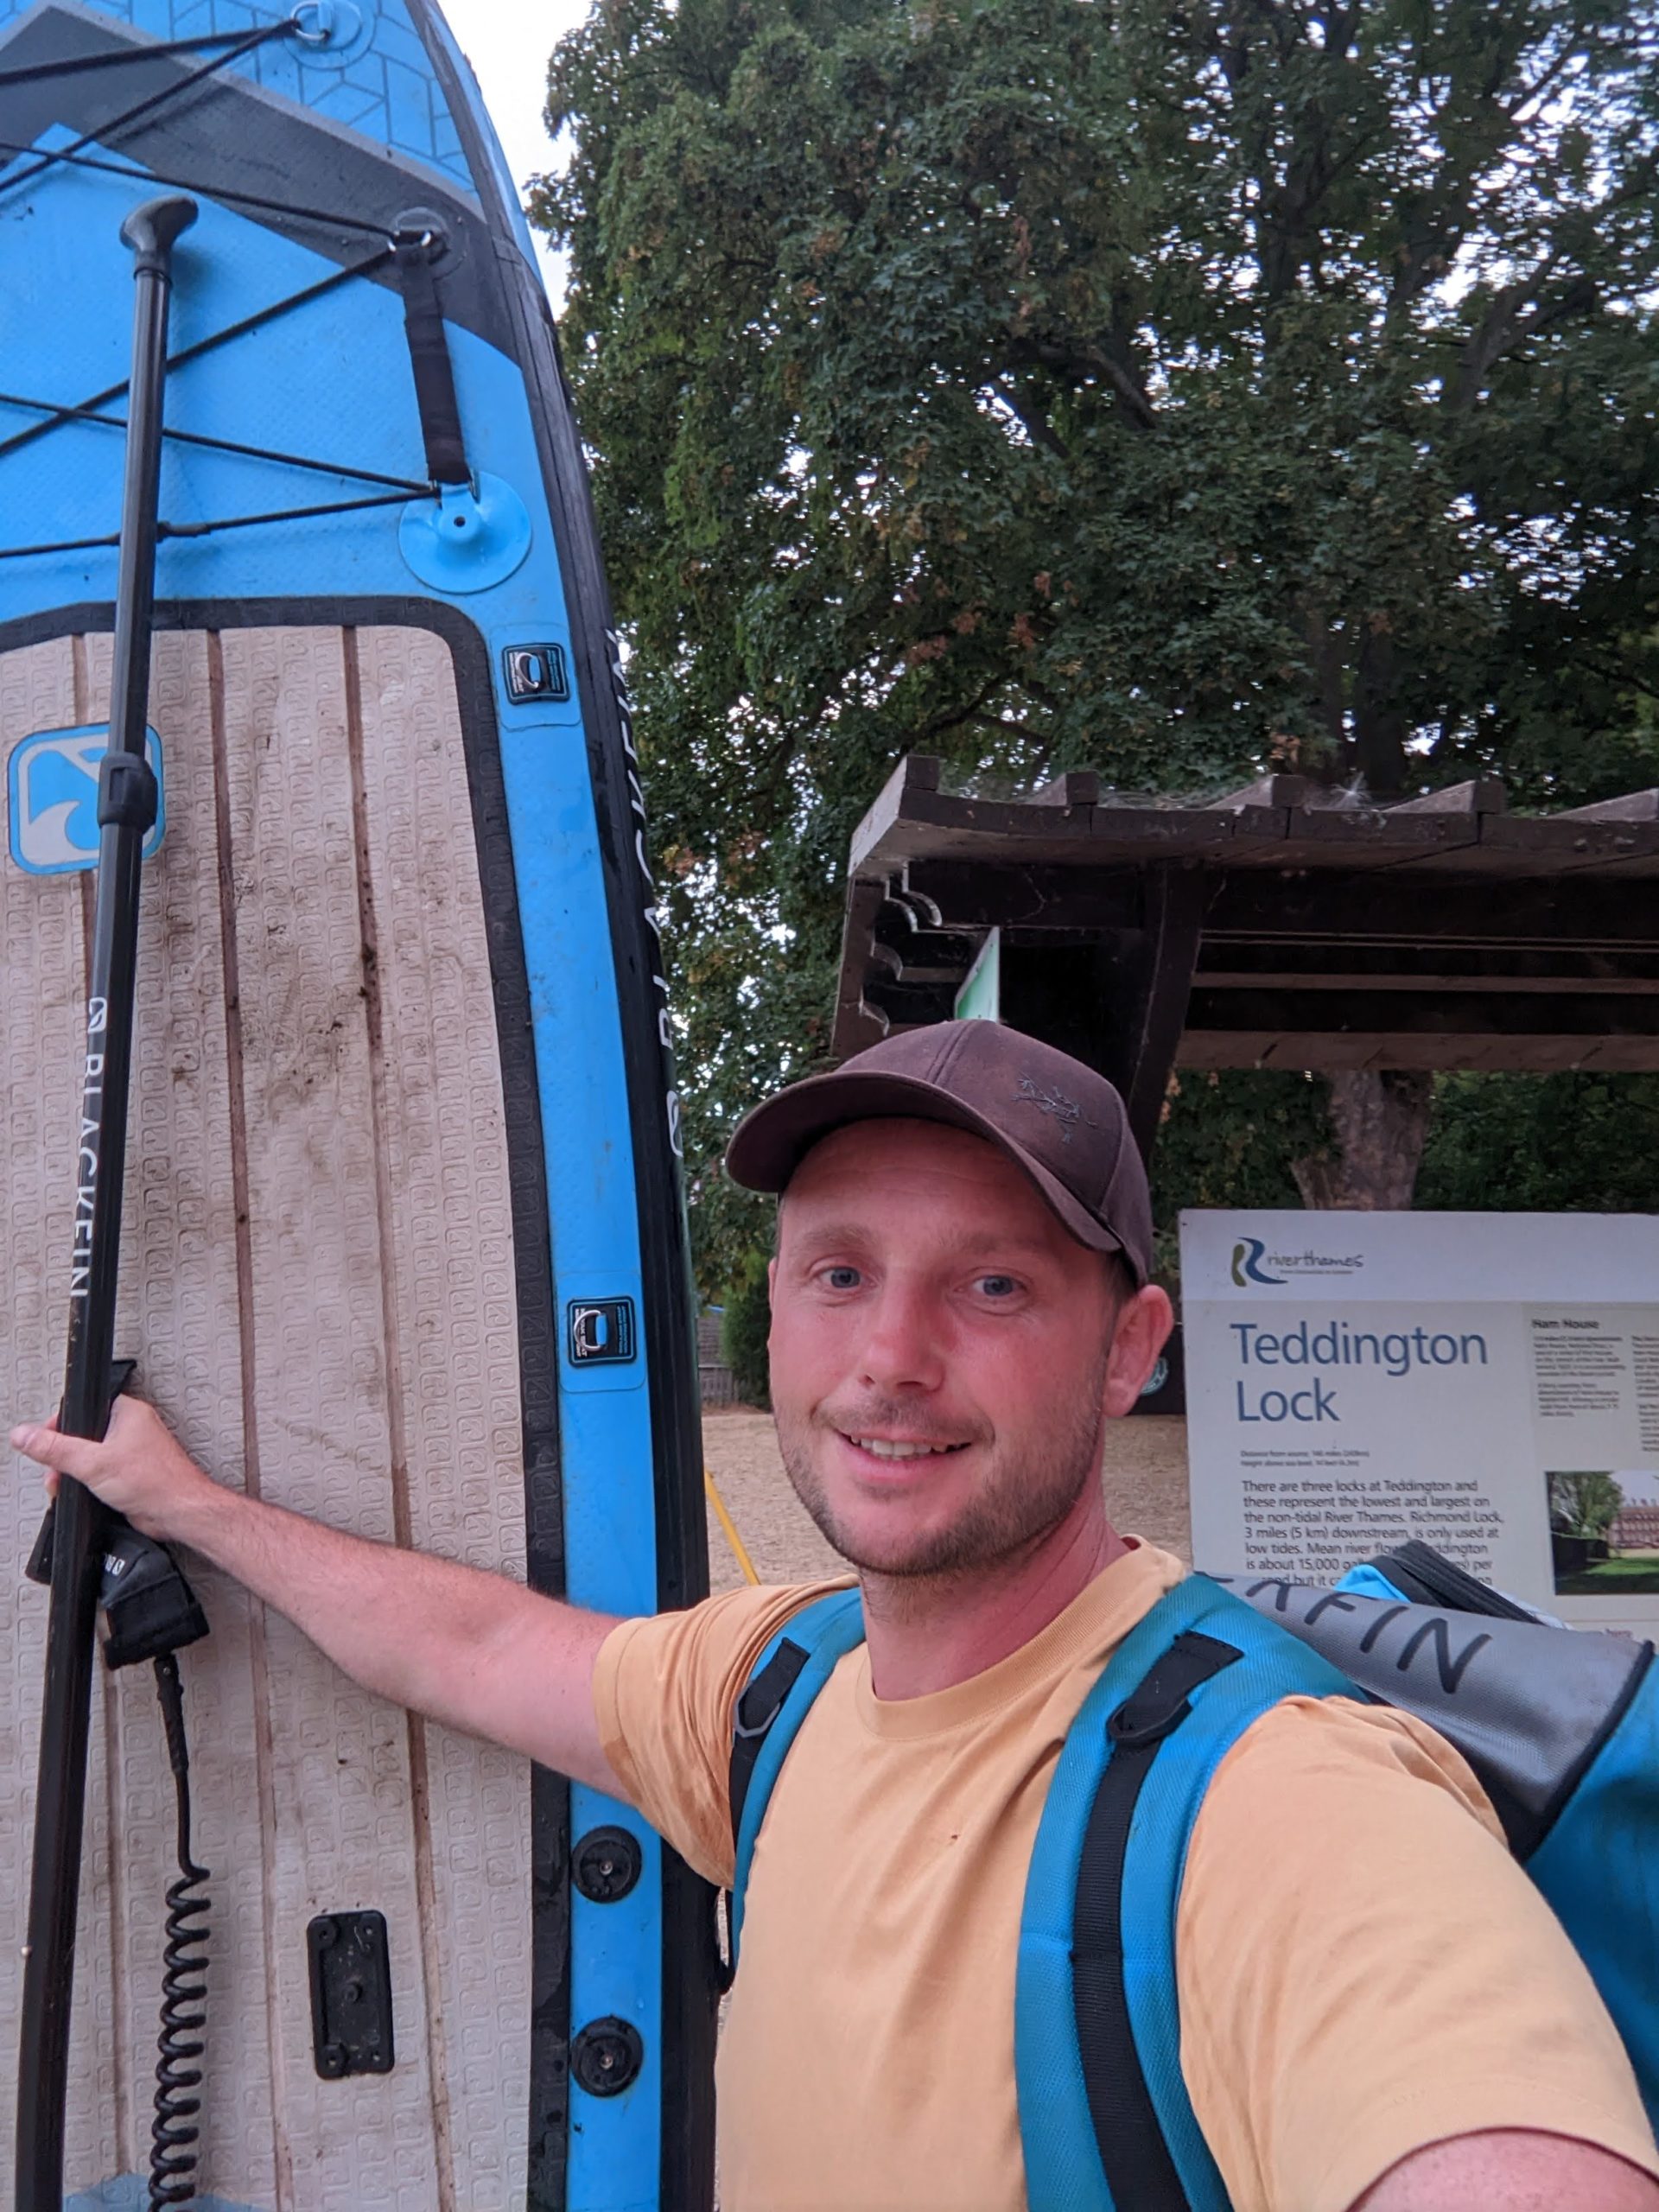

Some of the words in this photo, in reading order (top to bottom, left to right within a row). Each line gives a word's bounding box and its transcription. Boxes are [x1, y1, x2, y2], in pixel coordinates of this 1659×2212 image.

[1230, 1320, 1488, 1376] Teddington
[1237, 1376, 1340, 1421] Lock
[1242, 1479, 1276, 1492] There
[1280, 1482, 1299, 1492] are
[1301, 1479, 1333, 1492] three
[1336, 1479, 1366, 1492] locks
[1370, 1481, 1381, 1491] at
[1383, 1479, 1452, 1494] Teddington
[1455, 1480, 1478, 1491] and
[1244, 1496, 1276, 1508] these
[1280, 1497, 1336, 1510] represent
[1338, 1496, 1359, 1507] the
[1363, 1496, 1401, 1507] lowest
[1405, 1497, 1427, 1507] and
[1431, 1495, 1471, 1510] largest
[1474, 1497, 1491, 1507] on
[1244, 1511, 1263, 1522] the
[1268, 1511, 1321, 1522] non-tidal
[1325, 1511, 1353, 1522] River
[1409, 1511, 1471, 1522] Richmond
[1245, 1527, 1253, 1538] 3
[1256, 1526, 1287, 1538] miles
[1292, 1527, 1302, 1540] (5
[1306, 1526, 1328, 1540] km)
[1415, 1527, 1423, 1538] is
[1427, 1526, 1452, 1542] only
[1456, 1527, 1484, 1538] used
[1487, 1528, 1499, 1538] at
[1245, 1542, 1268, 1554] low
[1271, 1542, 1303, 1554] tides.
[1307, 1542, 1342, 1554] Mean
[1345, 1541, 1371, 1554] river
[1247, 1559, 1255, 1570] is
[1259, 1558, 1294, 1570] about
[1299, 1558, 1339, 1571] 15,000
[1473, 1560, 1493, 1571] per
[1318, 1575, 1326, 1586] it
